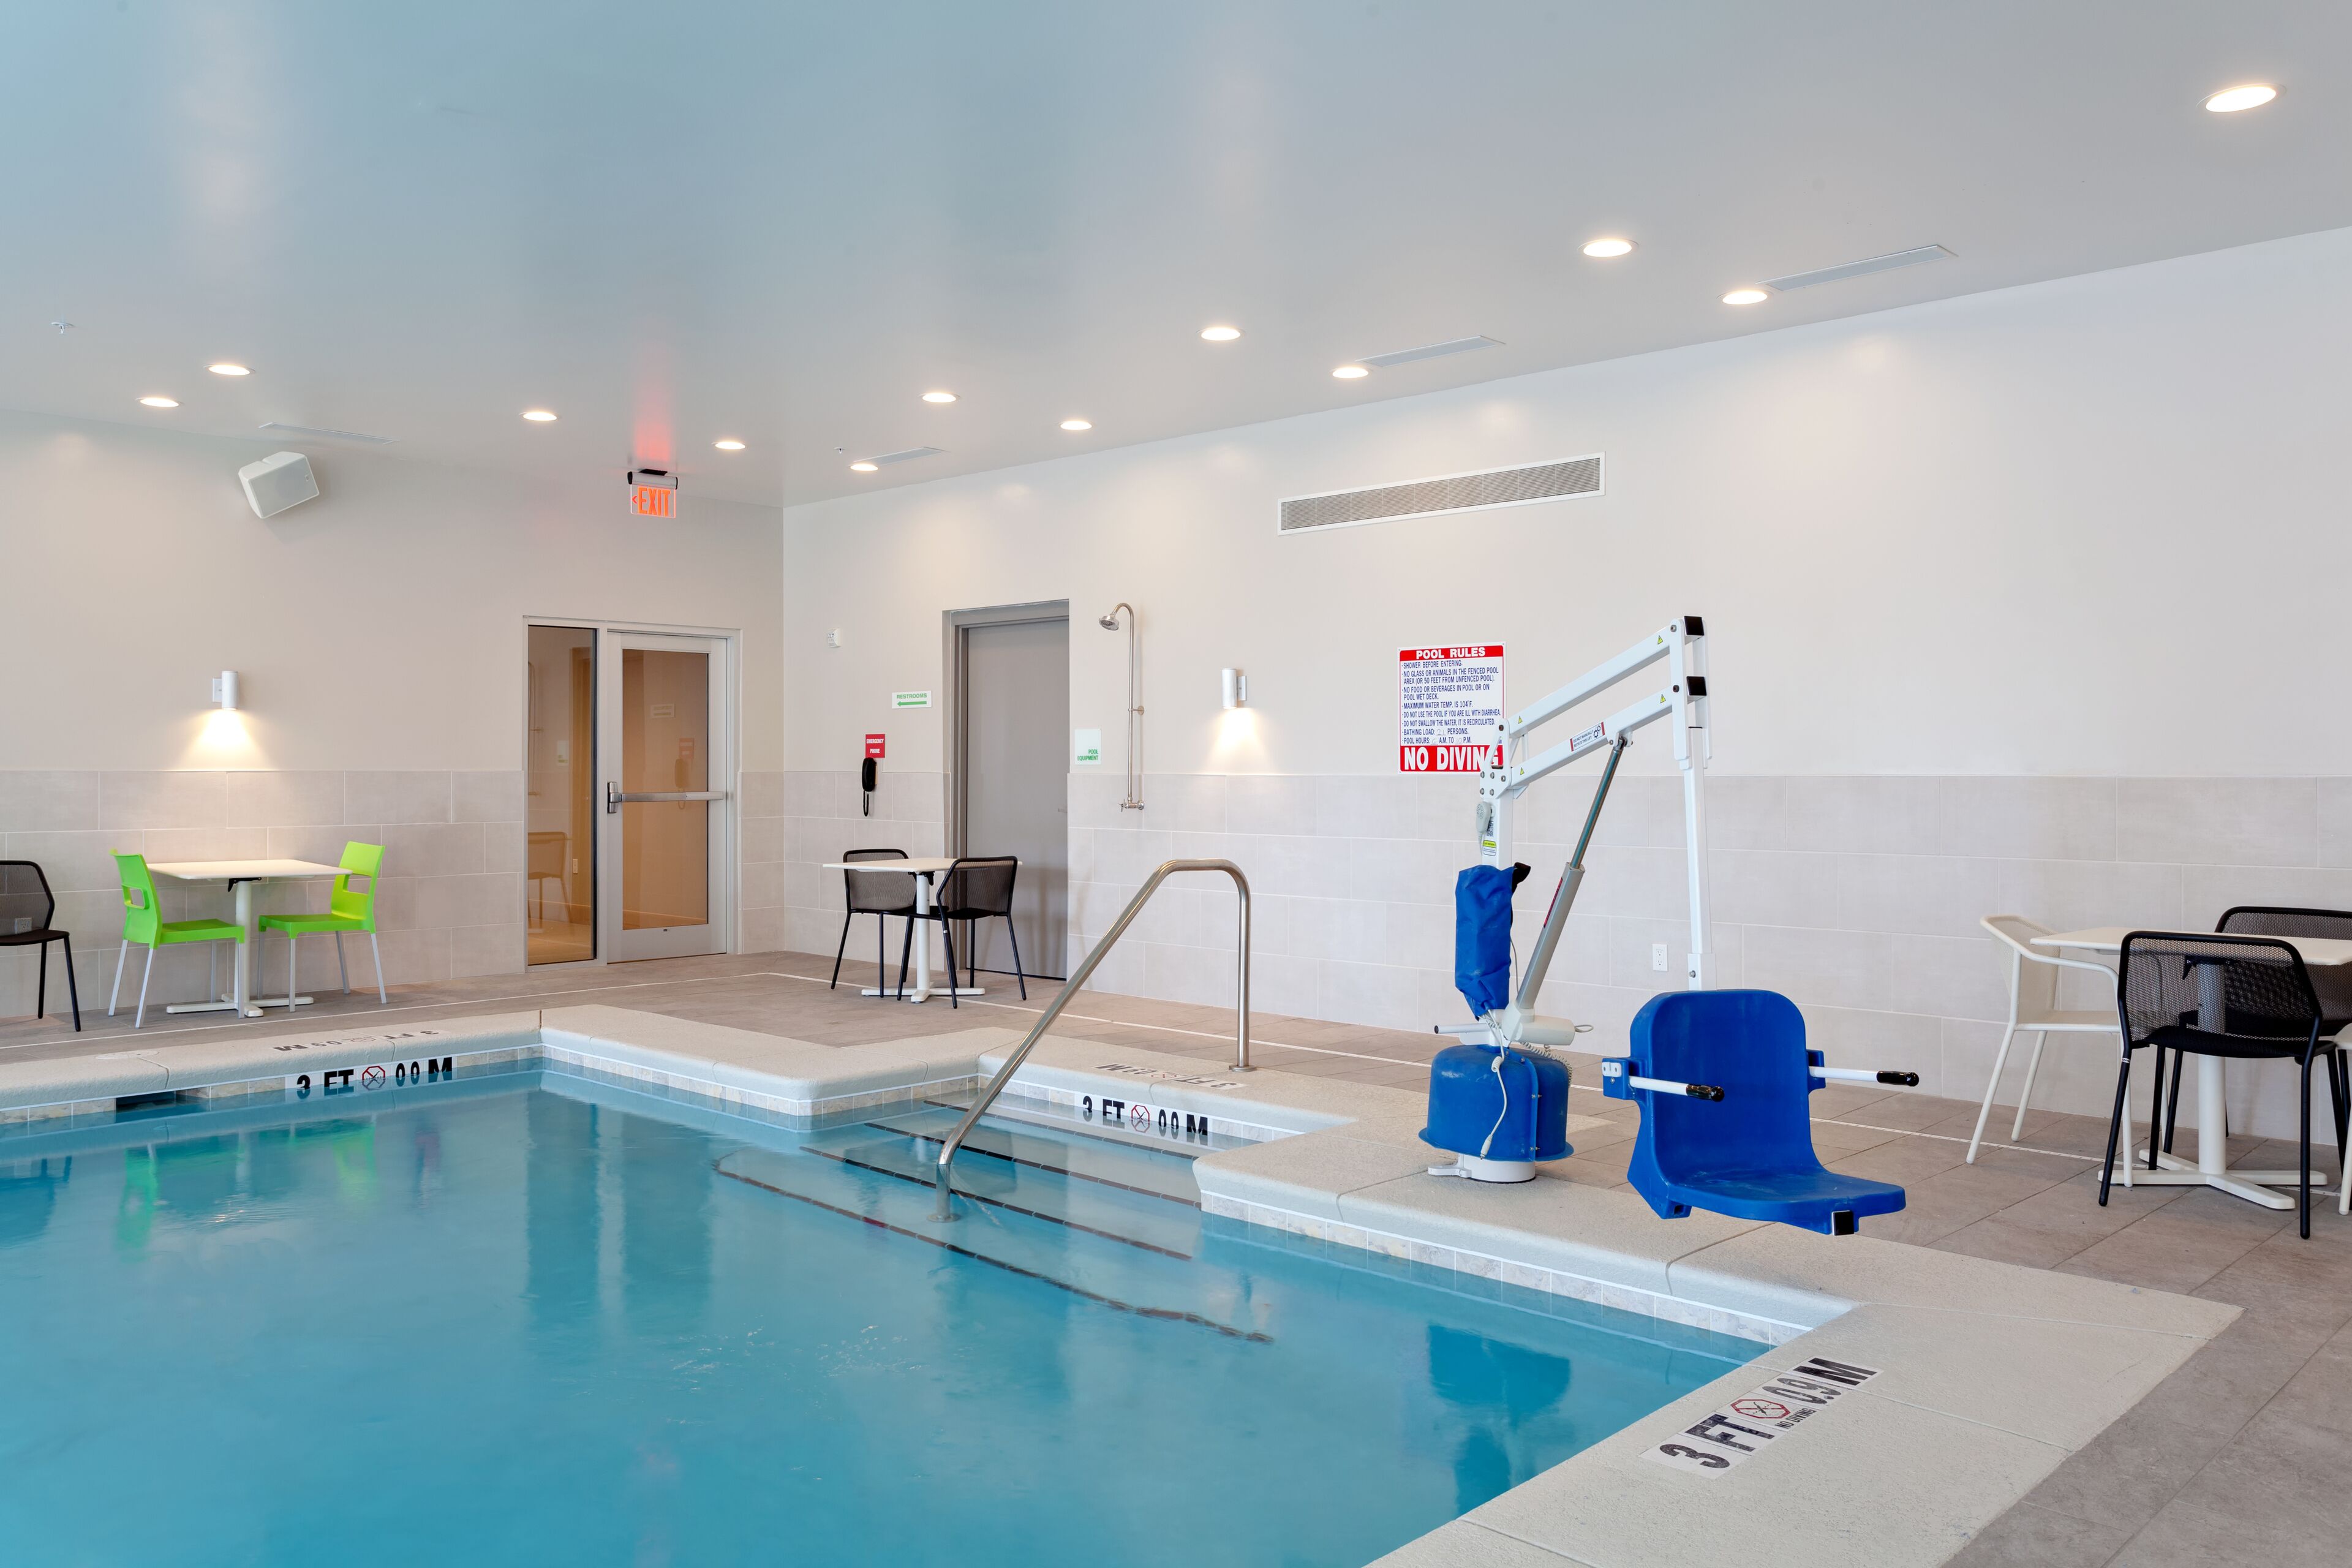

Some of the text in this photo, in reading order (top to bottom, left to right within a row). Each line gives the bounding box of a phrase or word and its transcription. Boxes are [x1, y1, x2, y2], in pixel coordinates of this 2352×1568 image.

[638, 487, 671, 516] EXIT
[1416, 647, 1485, 659] POOL RULES
[1480, 674, 1495, 683] POOL).
[1404, 747, 1429, 771] NO
[324, 1069, 354, 1088] FT
[1102, 1098, 1125, 1119] FT
[1659, 1357, 1877, 1469] 3 FT 0.9 M
[1774, 1408, 1818, 1429] NO DIVING
